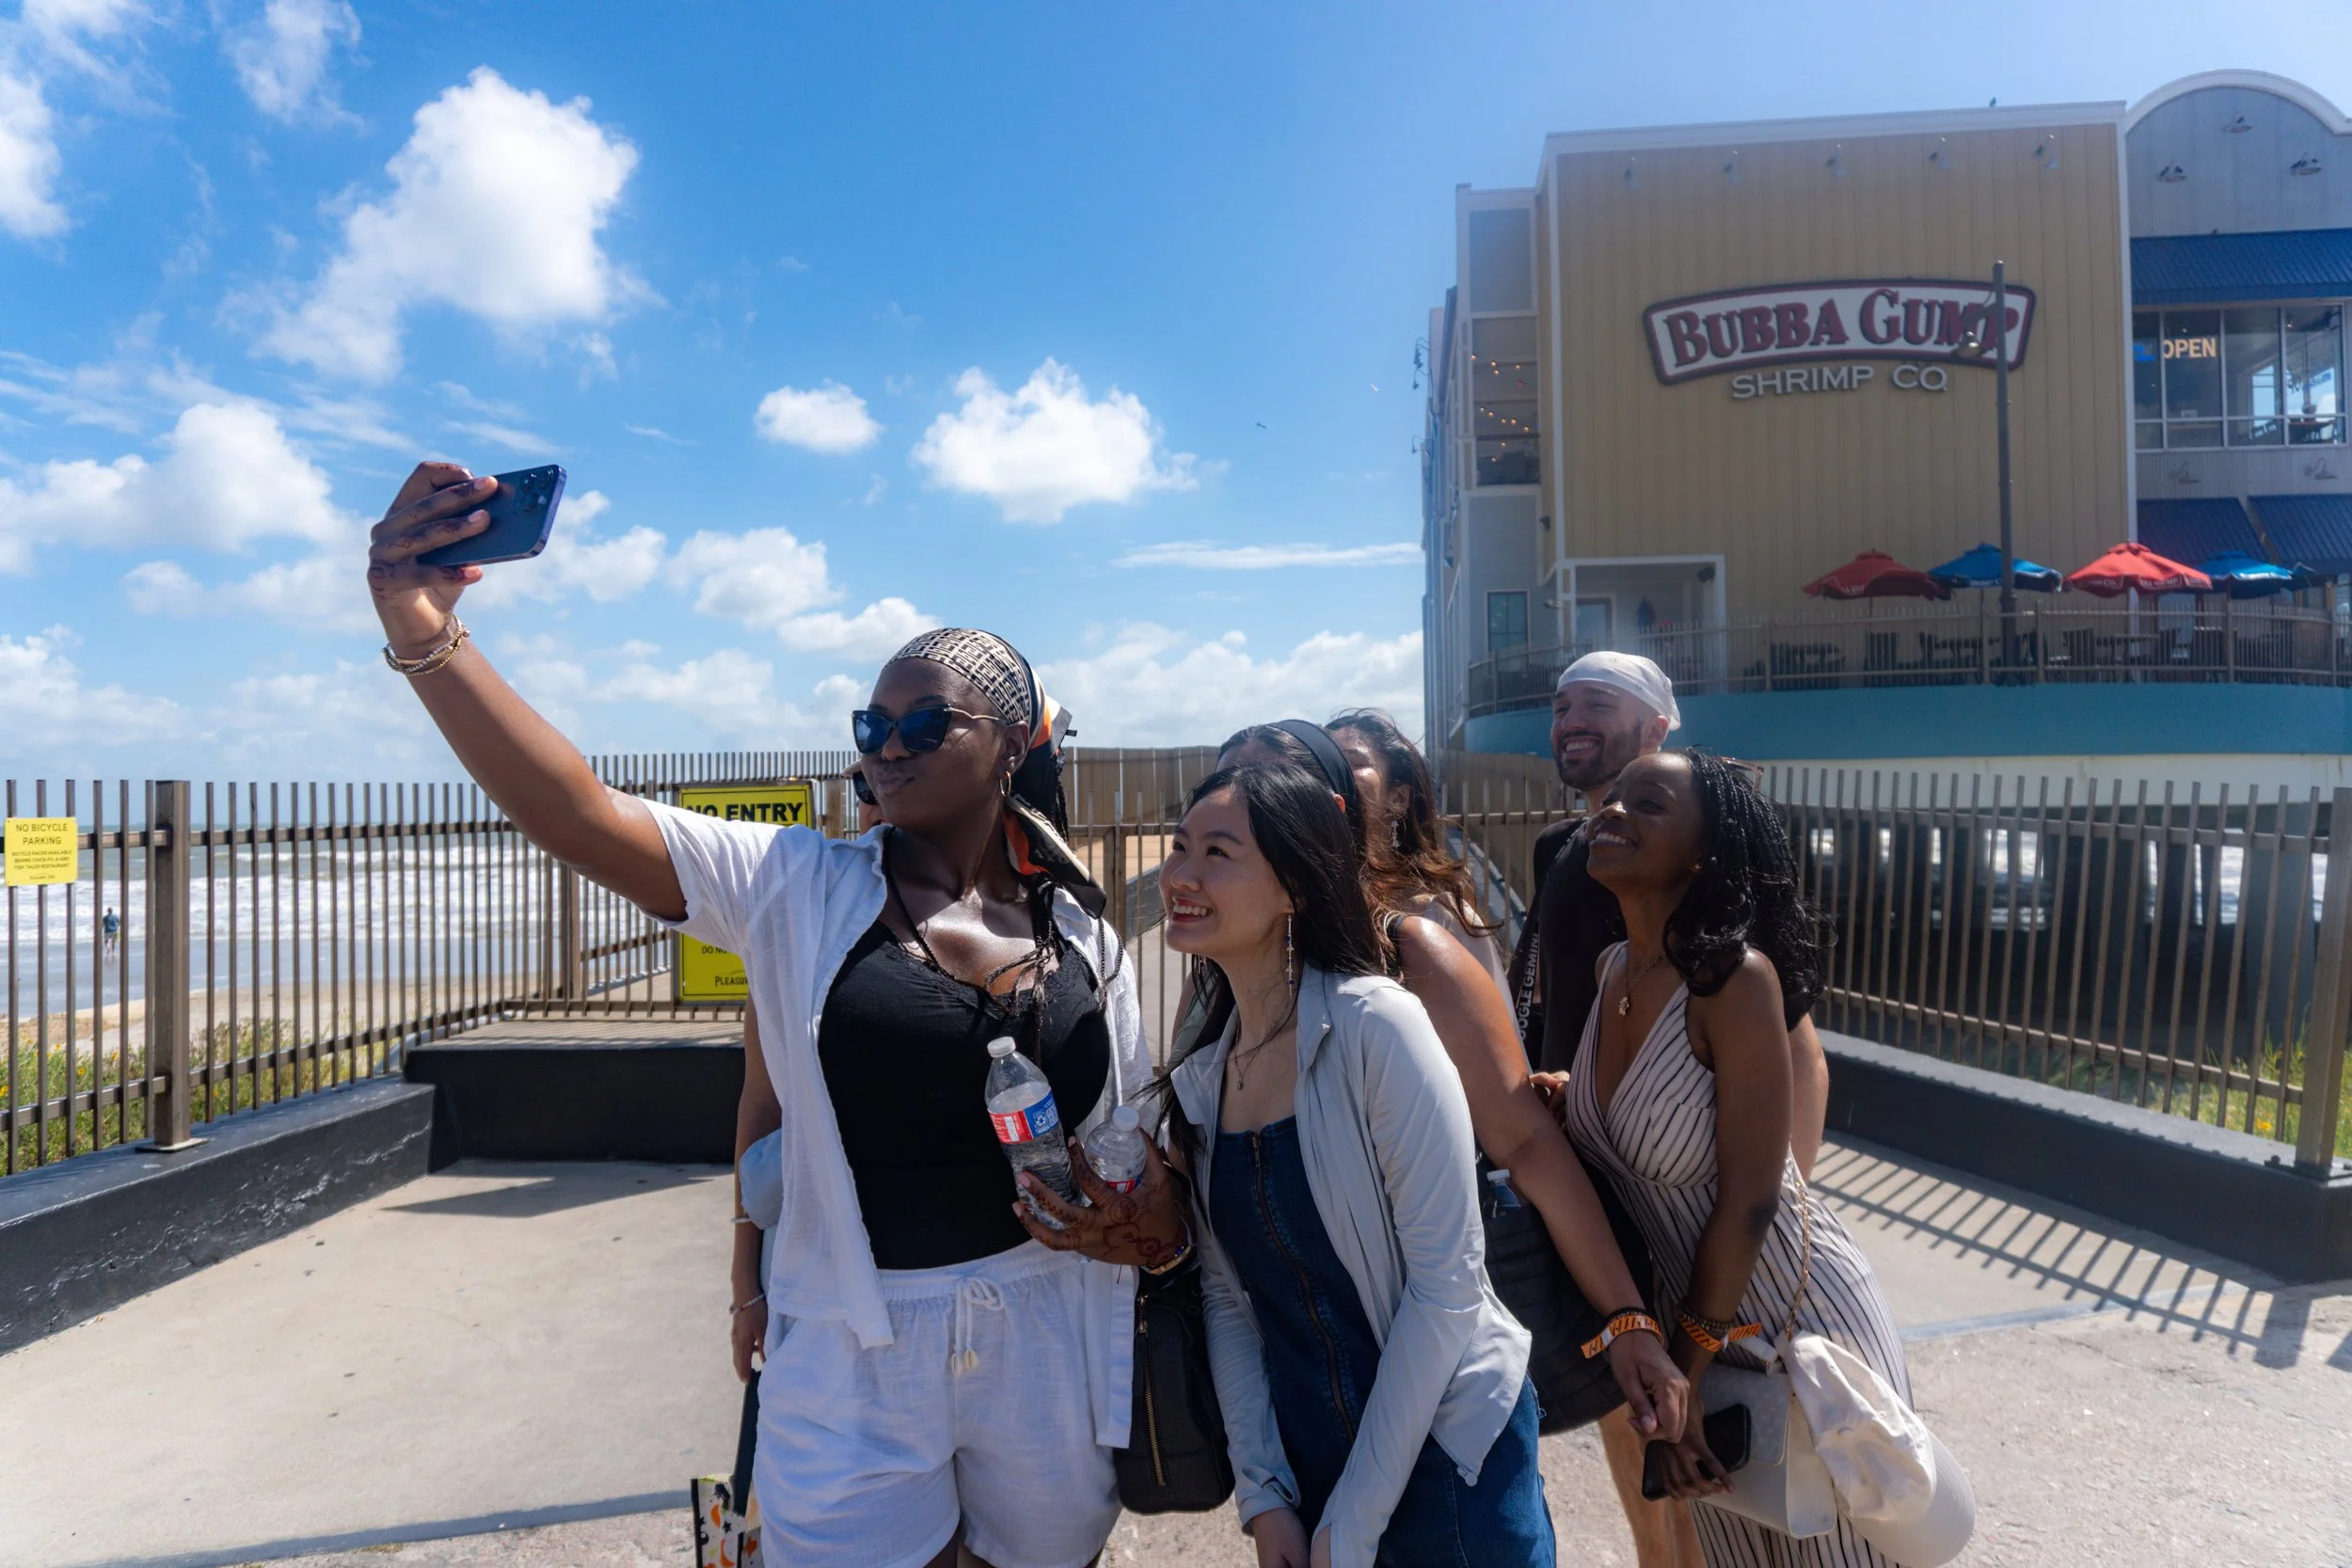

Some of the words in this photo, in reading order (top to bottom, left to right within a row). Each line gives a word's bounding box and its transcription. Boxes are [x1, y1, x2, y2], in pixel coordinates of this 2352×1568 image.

[1663, 297, 1851, 368] BUBBA
[1858, 287, 2019, 351] GUMP
[2163, 337, 2217, 359] OPEN
[1731, 365, 1875, 400] SHRIMP
[725, 802, 803, 821] ENTRY
[16, 824, 29, 832] NO
[31, 823, 68, 832] BICYCLE
[701, 945, 713, 955] DO
[1522, 933, 1539, 987] GEMINI
[1517, 990, 1533, 1041] OOGLE
